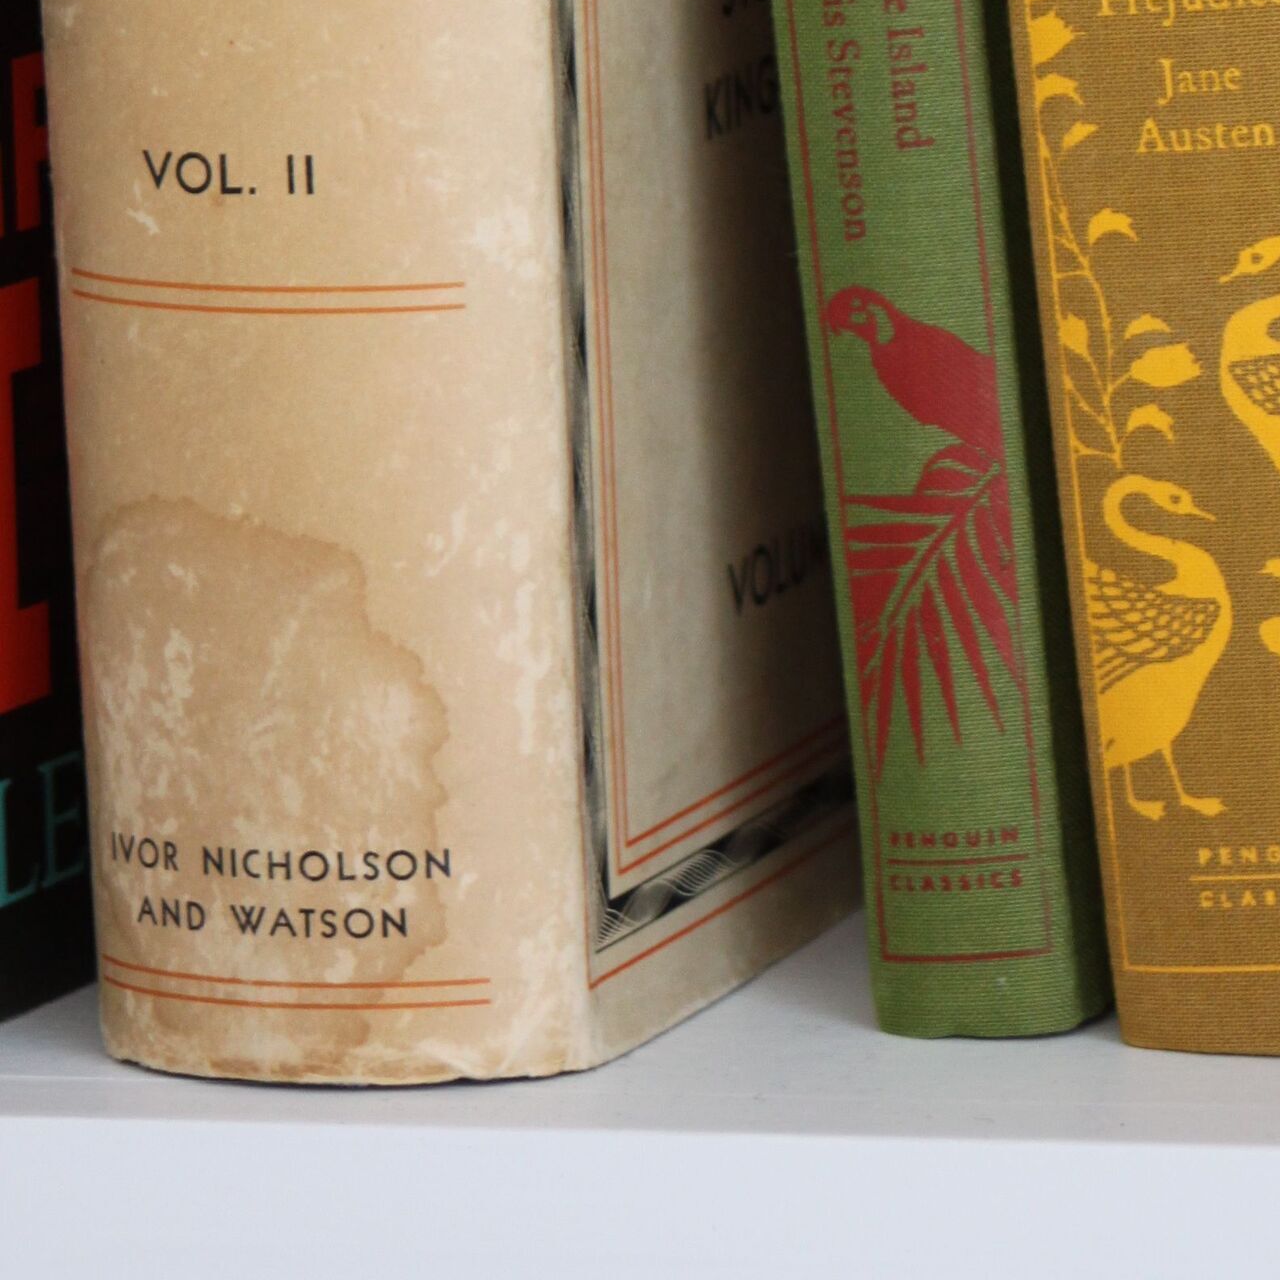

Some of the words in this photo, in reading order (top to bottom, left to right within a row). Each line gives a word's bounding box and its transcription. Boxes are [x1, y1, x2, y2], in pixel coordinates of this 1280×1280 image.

[704, 53, 778, 140] KING
[886, 26, 935, 152] Island
[1156, 57, 1243, 107] Jane
[827, 38, 868, 243] Stevenson
[1136, 116, 1277, 154] Austen
[142, 149, 258, 196] VOL.
[286, 154, 316, 196] II
[110, 831, 179, 872] IVOR
[202, 846, 453, 883] NICHOLSON
[889, 824, 1020, 850] PENGUIN
[889, 868, 1024, 892] CLASSICS
[137, 895, 206, 931] AND
[229, 903, 409, 940] WATSON
